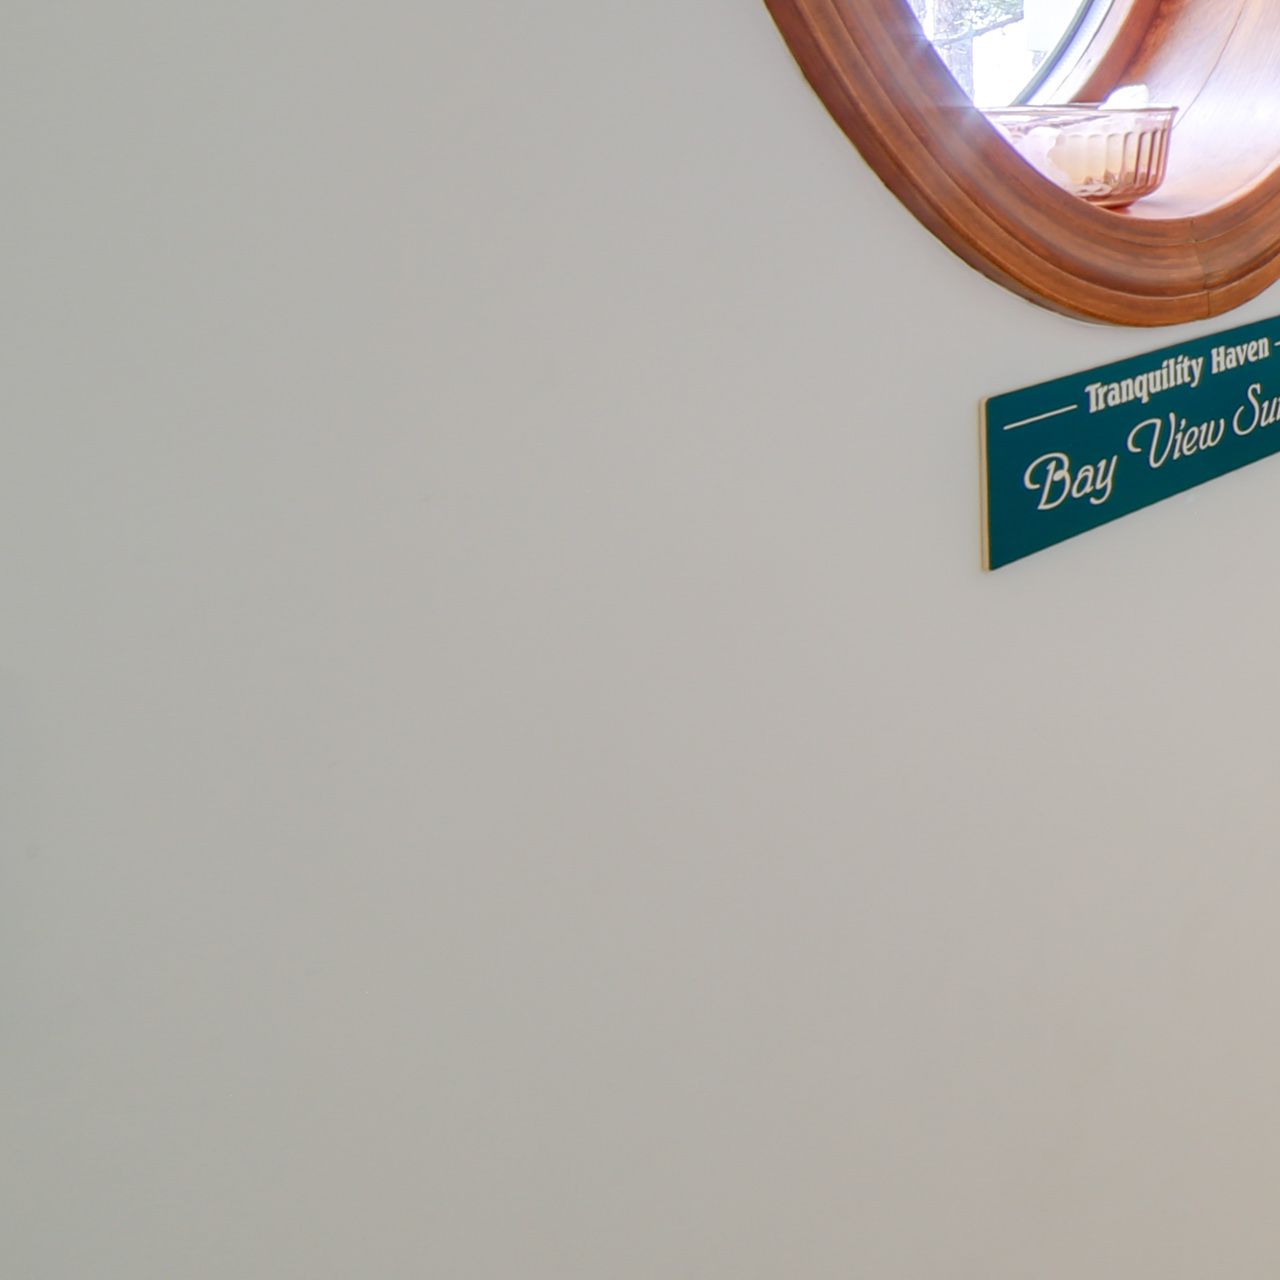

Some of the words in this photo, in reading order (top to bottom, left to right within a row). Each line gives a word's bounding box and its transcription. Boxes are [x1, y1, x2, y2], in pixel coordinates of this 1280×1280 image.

[1085, 354, 1203, 413] Tranquility
[1211, 336, 1270, 374] Haven
[1023, 452, 1118, 510] Bay
[1127, 411, 1225, 468] View
